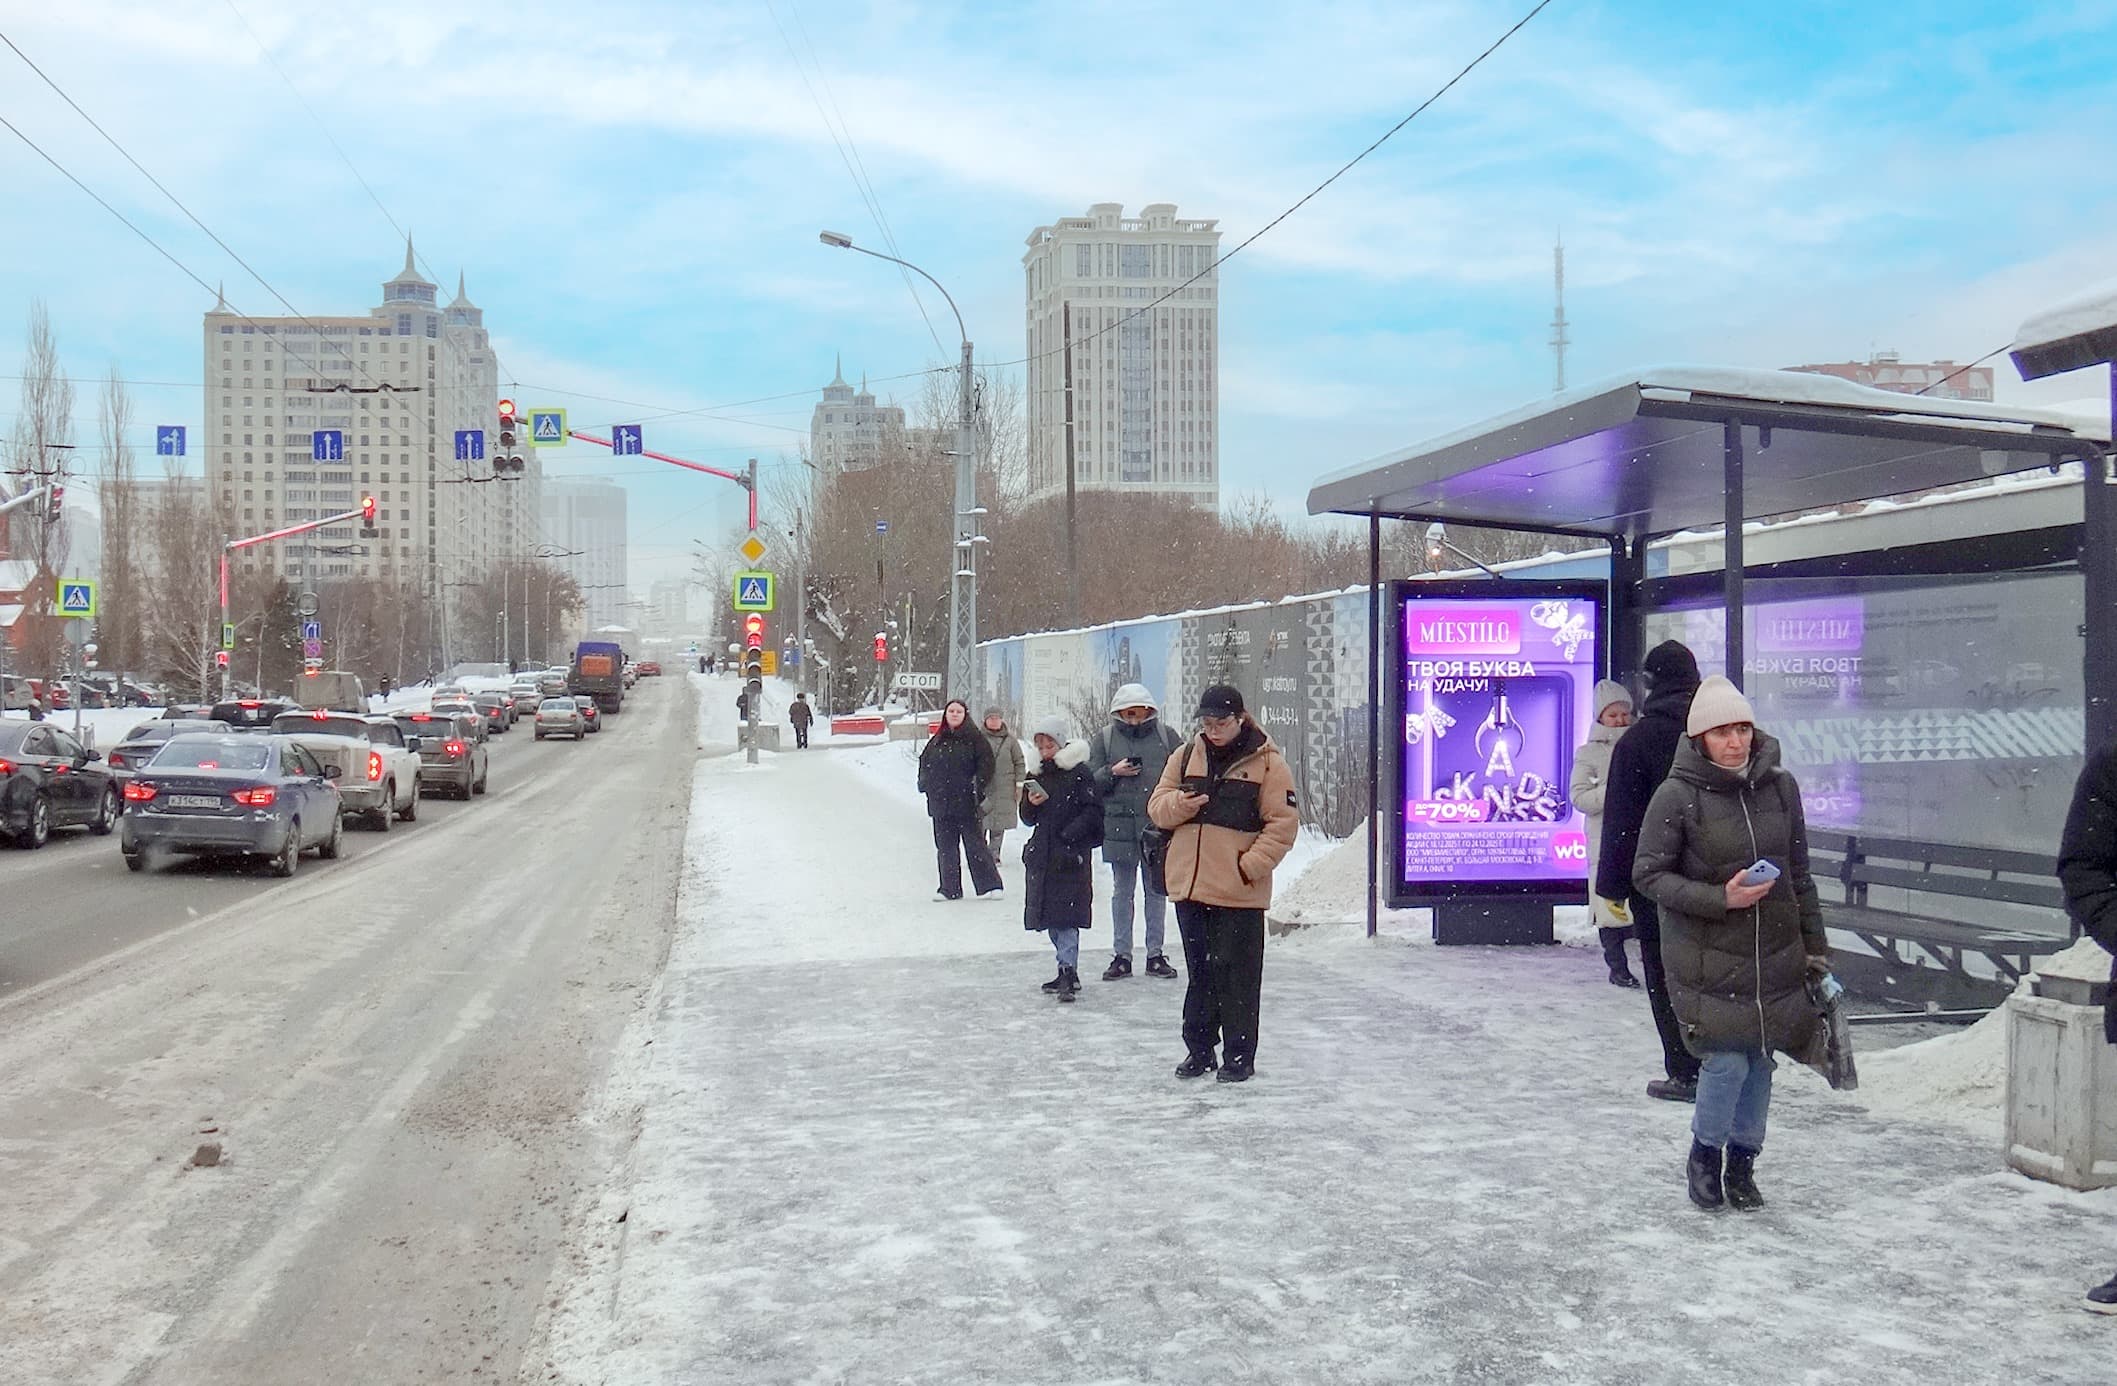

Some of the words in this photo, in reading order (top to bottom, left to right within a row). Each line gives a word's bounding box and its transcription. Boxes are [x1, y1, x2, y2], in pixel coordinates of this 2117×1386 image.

[1420, 616, 1509, 643] MÍESTÍLO
[1408, 661, 1464, 677] ТВОЯ
[1469, 661, 1535, 677] БУКВА
[899, 675, 937, 686] СТОП
[1408, 679, 1430, 691] НА
[1434, 679, 1489, 694] УДАЧУ!
[1554, 840, 1586, 859] wb
